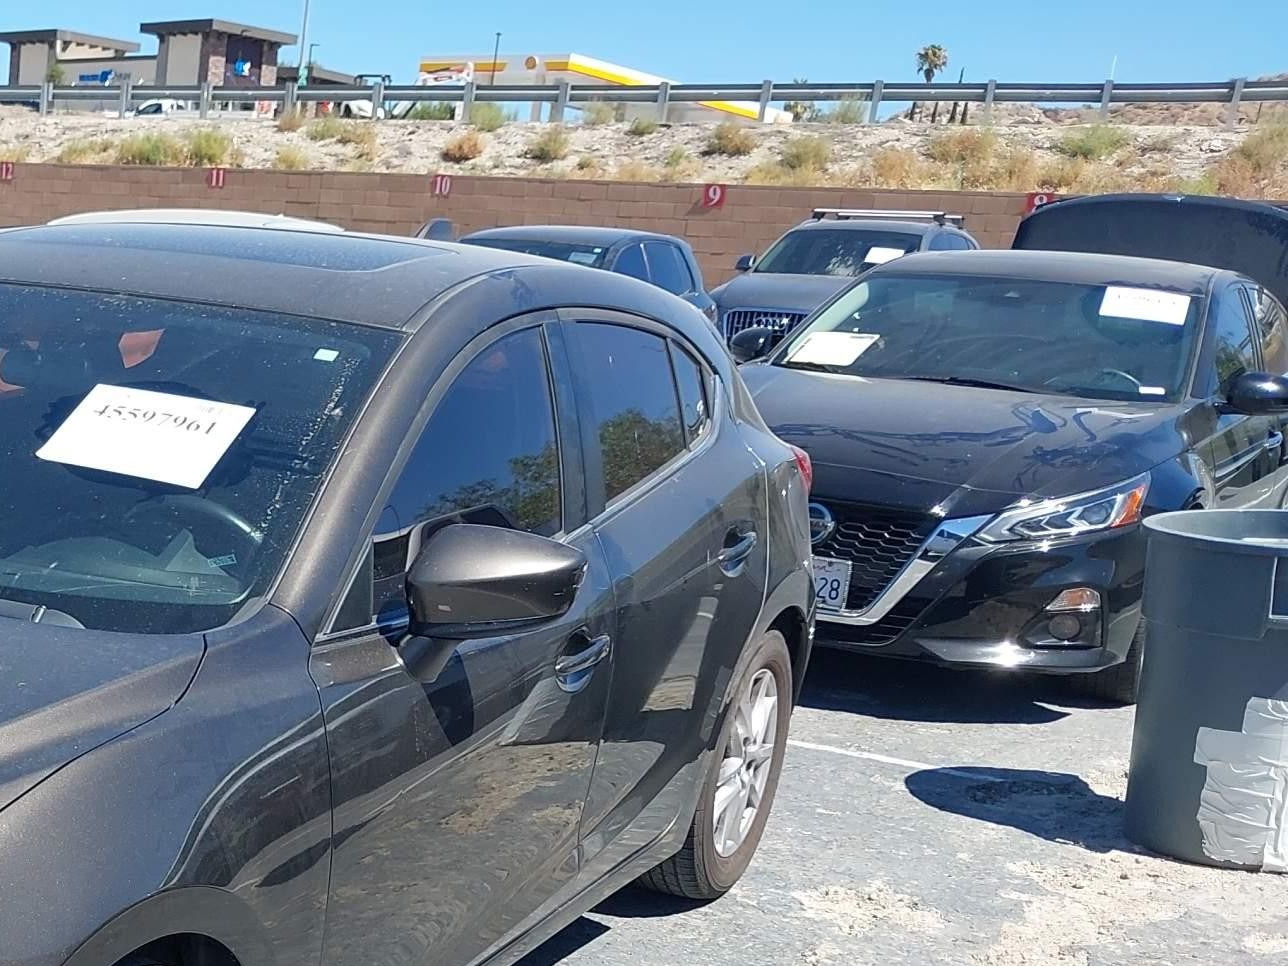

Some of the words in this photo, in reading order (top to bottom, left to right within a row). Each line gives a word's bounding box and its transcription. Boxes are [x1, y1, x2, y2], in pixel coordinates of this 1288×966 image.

[1, 162, 13, 180] 12
[211, 168, 224, 187] 11
[434, 175, 451, 195] 10
[708, 184, 721, 206] 9
[93, 403, 217, 435] 45597961
[814, 576, 841, 601] 28
